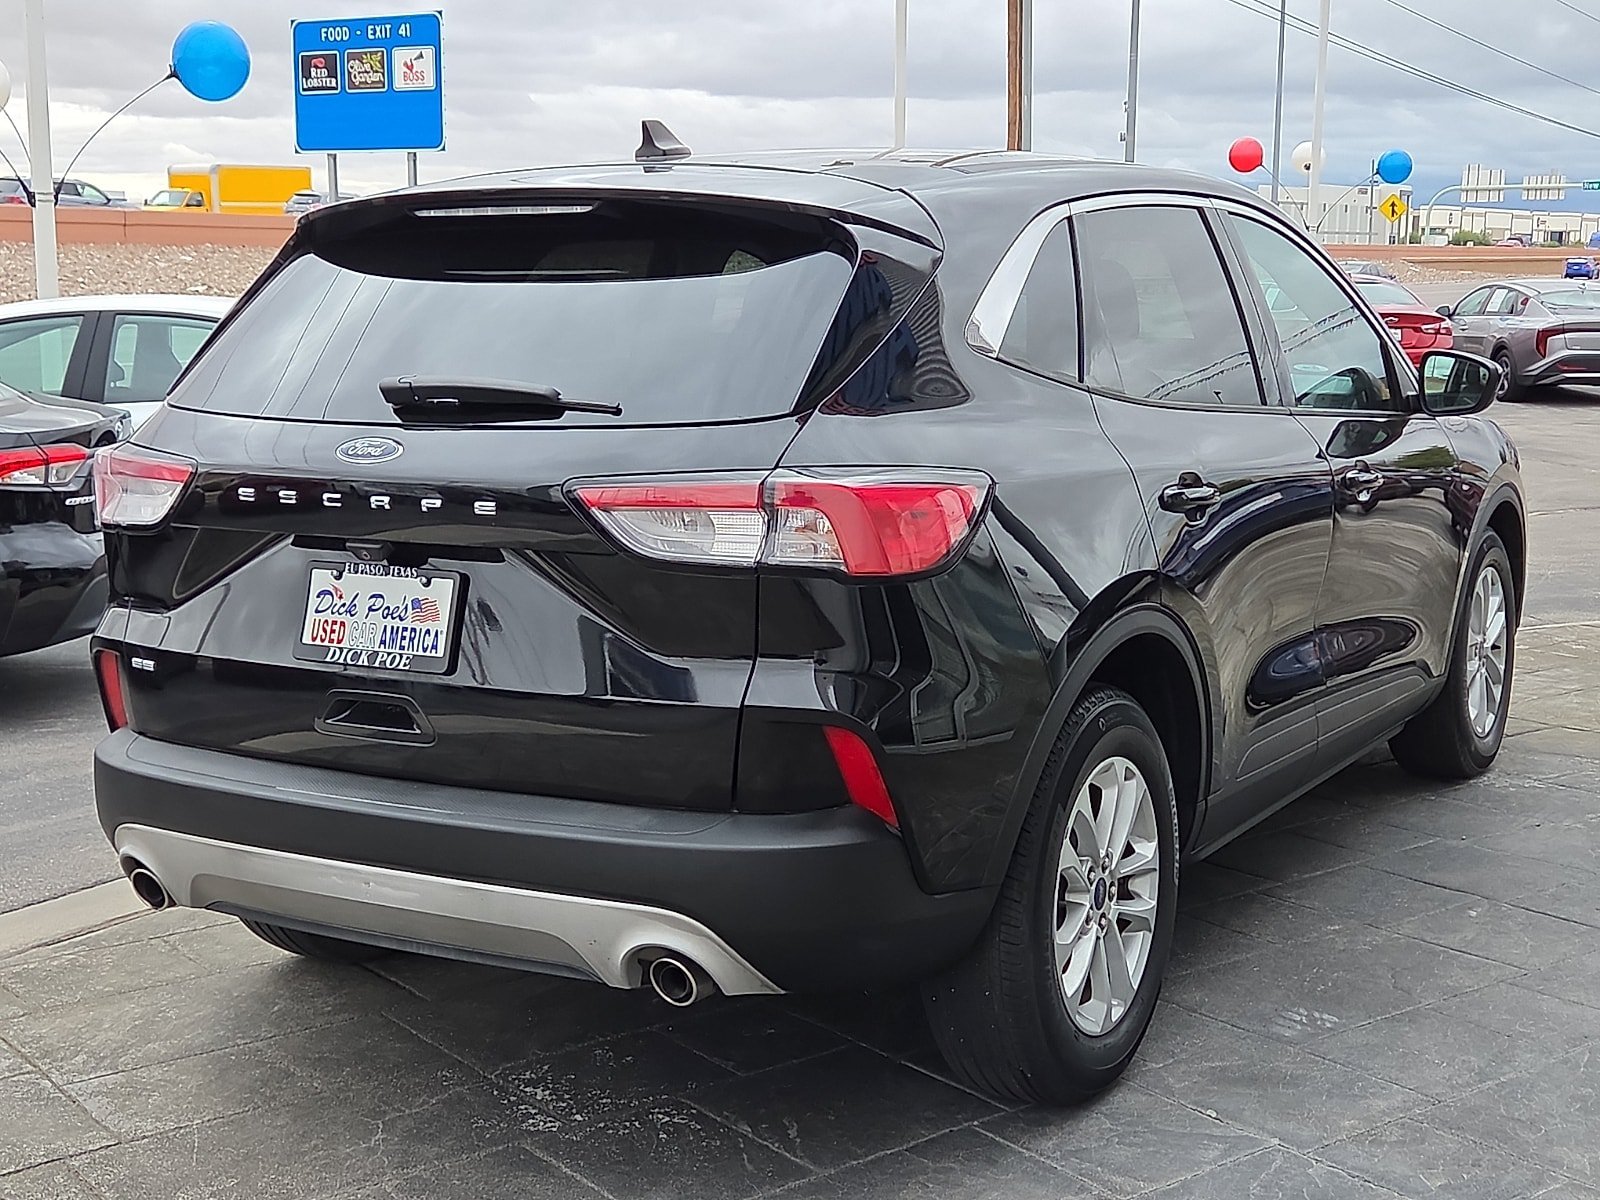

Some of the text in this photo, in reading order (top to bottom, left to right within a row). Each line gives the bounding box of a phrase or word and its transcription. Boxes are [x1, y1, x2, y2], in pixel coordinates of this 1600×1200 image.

[321, 26, 350, 41] FOOD
[367, 24, 392, 39] EXIT
[398, 23, 411, 37] 41
[311, 67, 328, 78] RED
[403, 70, 425, 82] BOSS
[302, 77, 337, 88] LOBSTER
[347, 440, 388, 456] Ford
[238, 487, 497, 516] ESCAPE
[389, 566, 418, 579] TEXAS
[314, 589, 360, 617] Dick
[311, 618, 439, 654] USED CAR AMERICA
[325, 647, 414, 670] DICK POE
